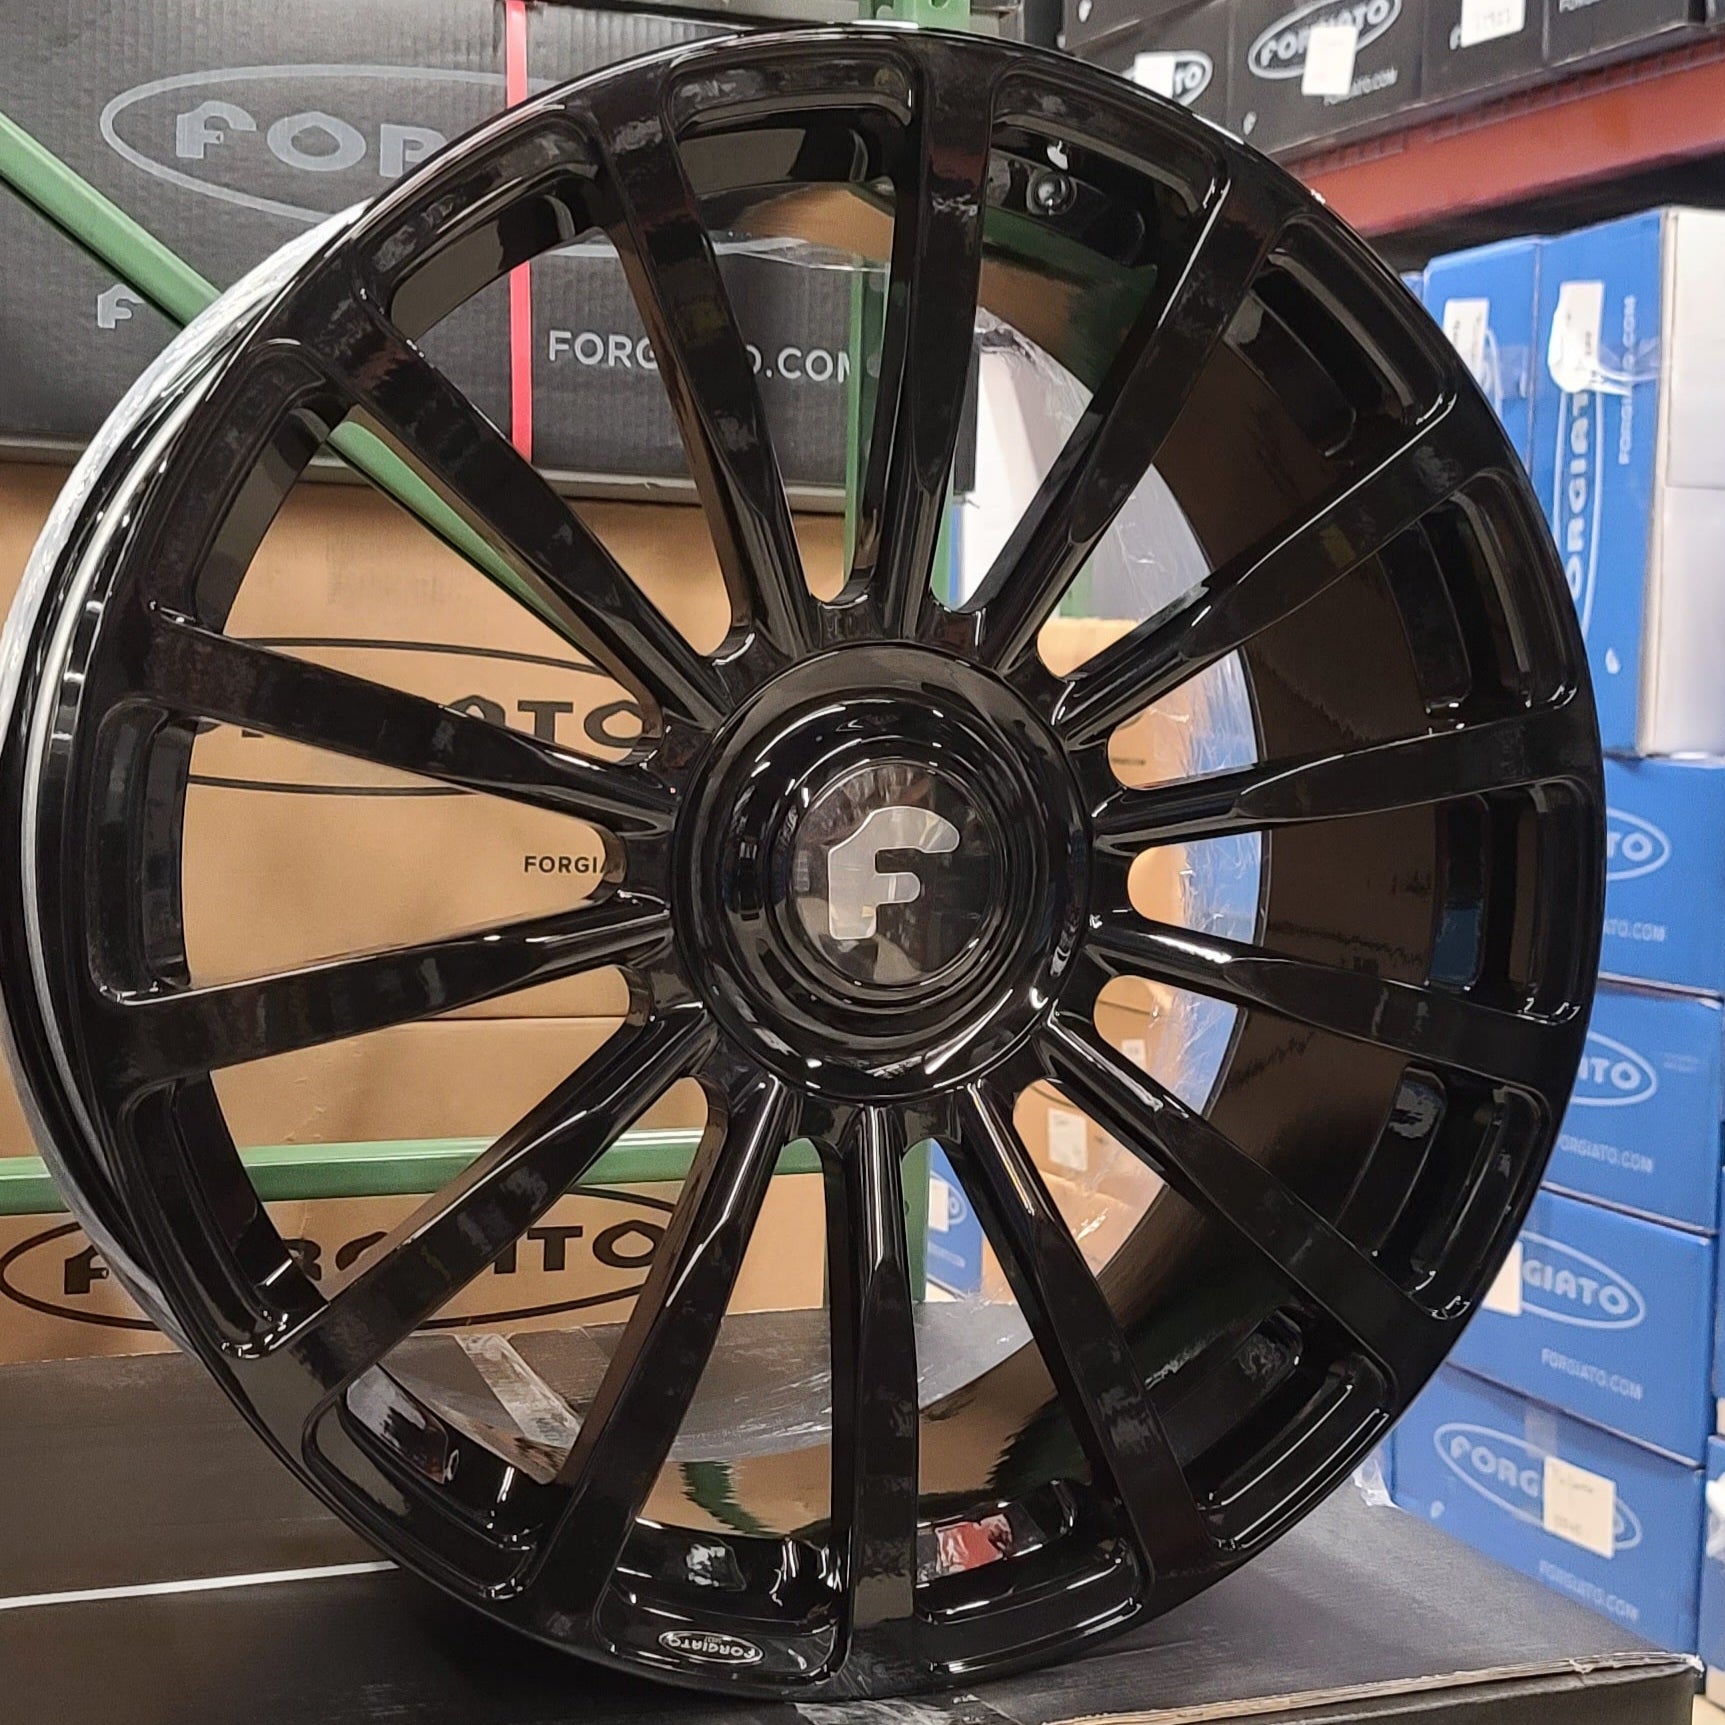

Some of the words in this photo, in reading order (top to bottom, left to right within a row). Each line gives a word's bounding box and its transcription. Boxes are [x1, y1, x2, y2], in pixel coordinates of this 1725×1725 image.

[523, 855, 601, 874] FORGI
[1559, 1134, 1654, 1174] ORGIATO.COM
[1522, 1259, 1629, 1316] GIATO
[1541, 1348, 1644, 1401] FORGIATO.COM
[666, 1637, 757, 1659] FORGIATO
